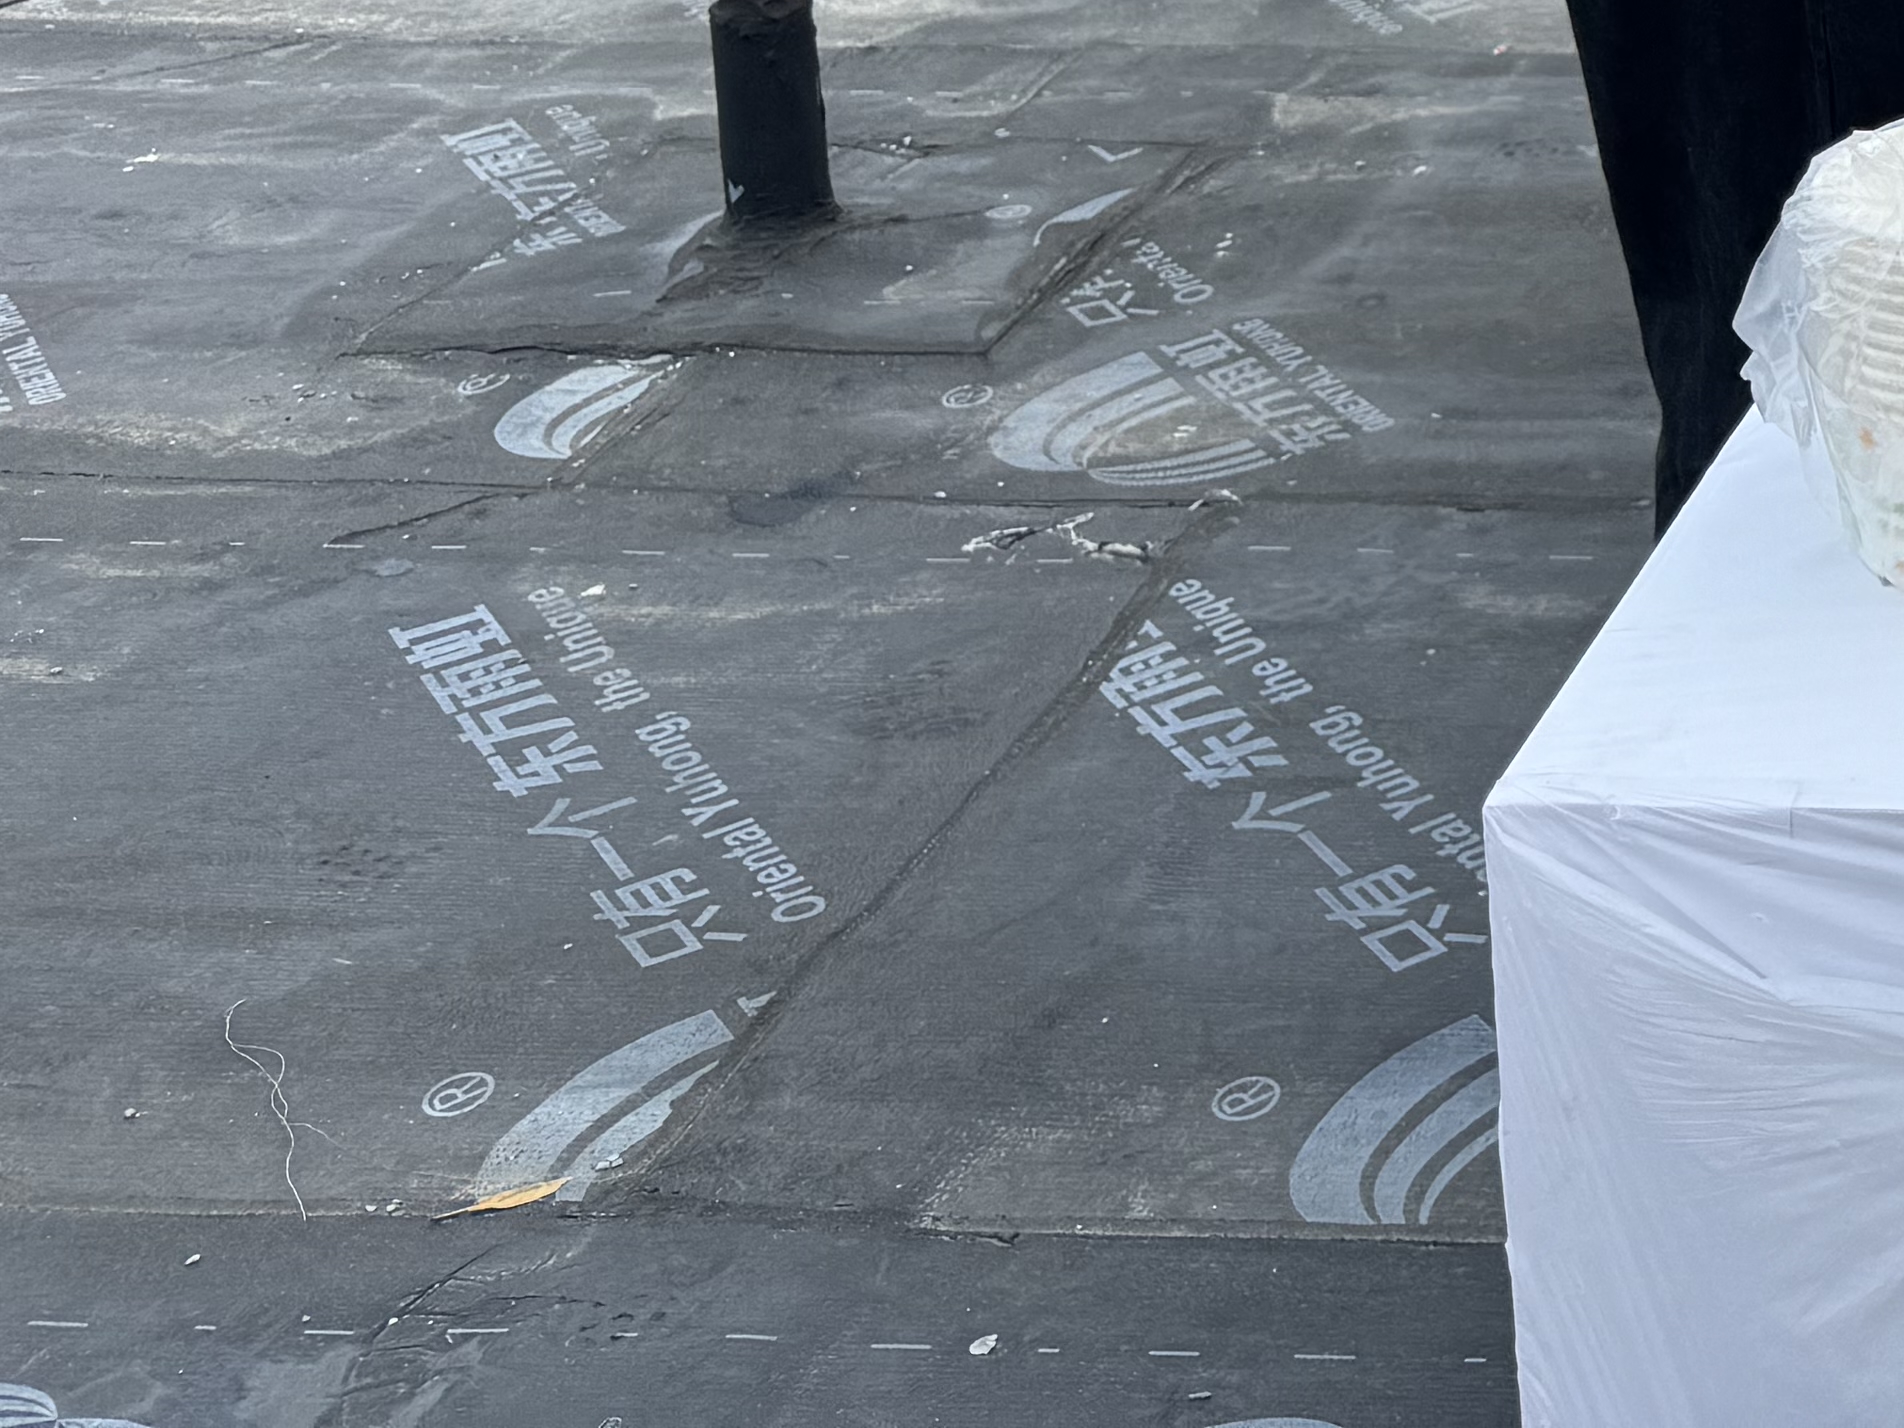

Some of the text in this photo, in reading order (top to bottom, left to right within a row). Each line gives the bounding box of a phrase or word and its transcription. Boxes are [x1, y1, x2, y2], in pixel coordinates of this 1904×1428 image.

[1158, 328, 1353, 455] 东方雨虹
[1231, 317, 1396, 434] ORIENTAL YUHONG
[1168, 578, 1267, 666] Unique
[1251, 656, 1314, 705] the
[388, 603, 748, 968] 只有一个东方雨虹
[527, 586, 827, 924] Oriental Yuhong, the Unique
[1099, 620, 1489, 973] 只有一个东方雨
[1308, 704, 1435, 822] Yuhong,
